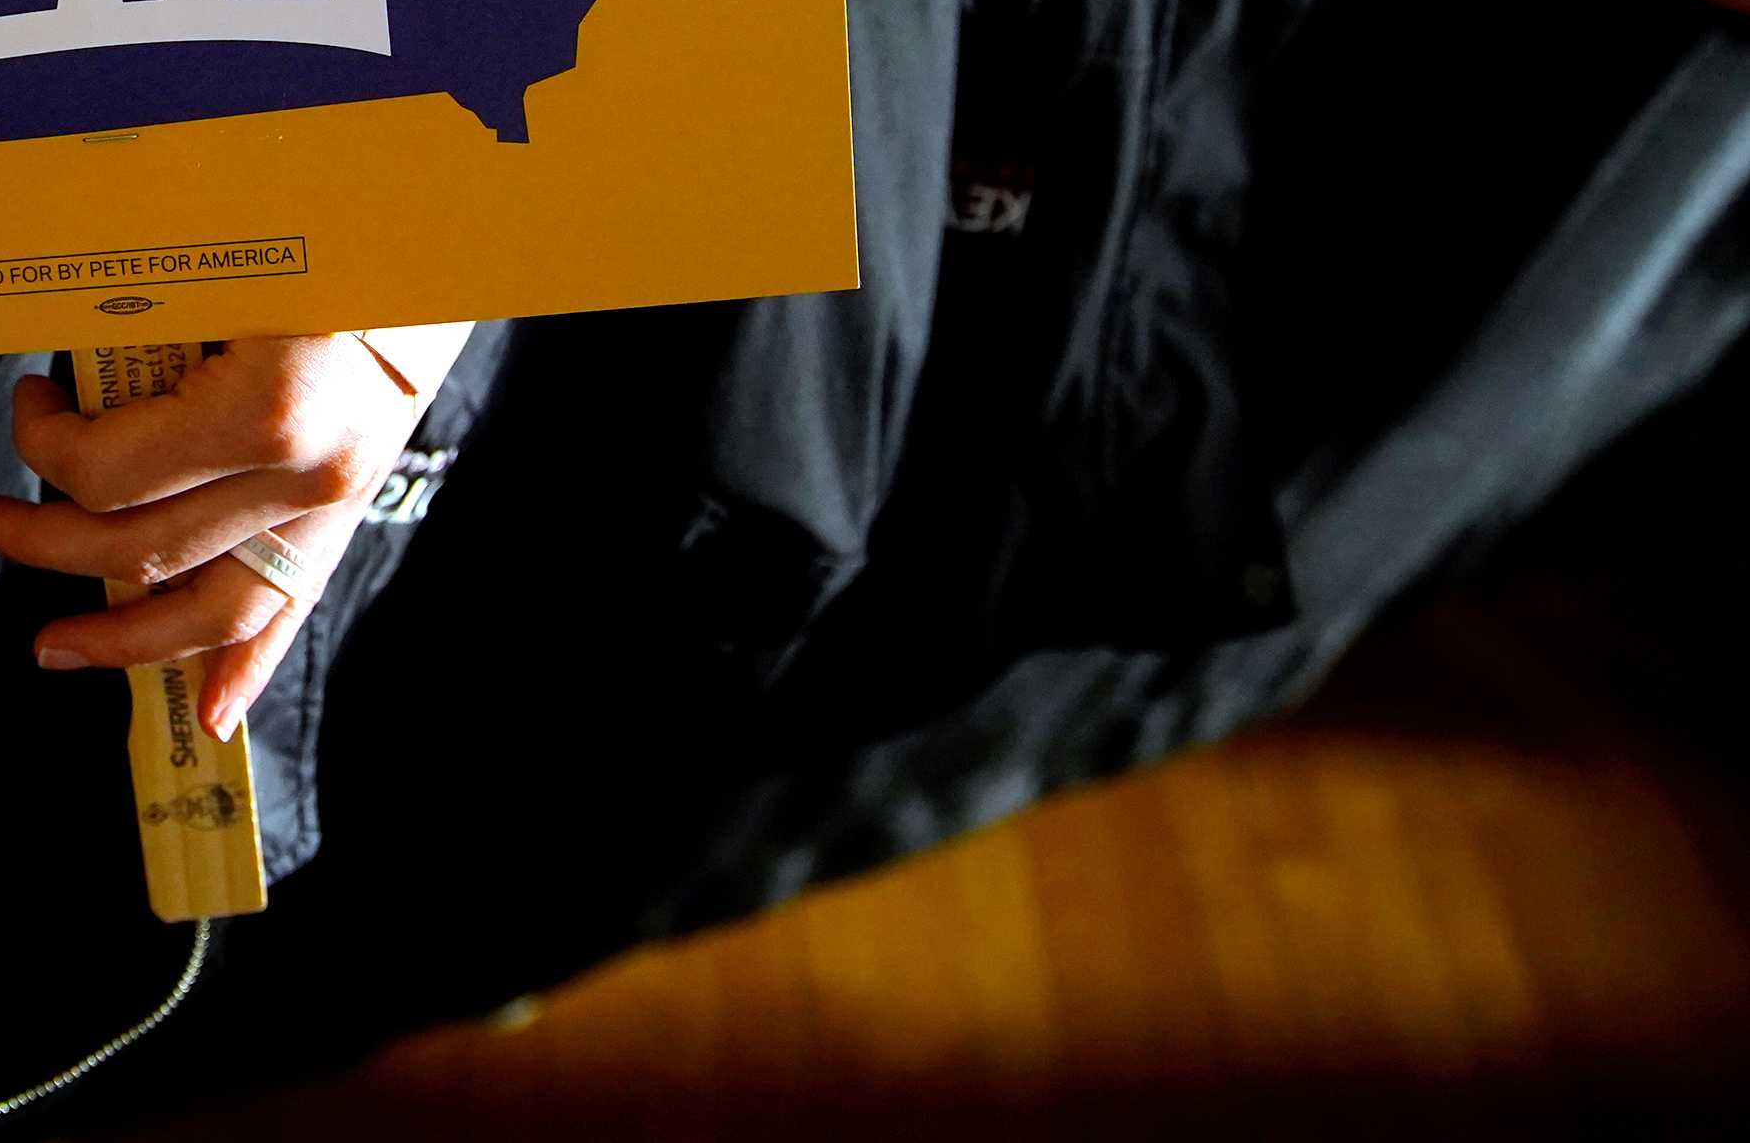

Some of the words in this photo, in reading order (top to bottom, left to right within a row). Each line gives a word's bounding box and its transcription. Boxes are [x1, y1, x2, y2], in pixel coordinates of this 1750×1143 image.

[9, 264, 53, 285] FOR
[58, 261, 85, 281] BY
[89, 257, 145, 278] PETE
[148, 253, 193, 274] FOR
[196, 246, 297, 270] AMERICA
[124, 356, 144, 398] may
[161, 667, 199, 768] SHERWIN
